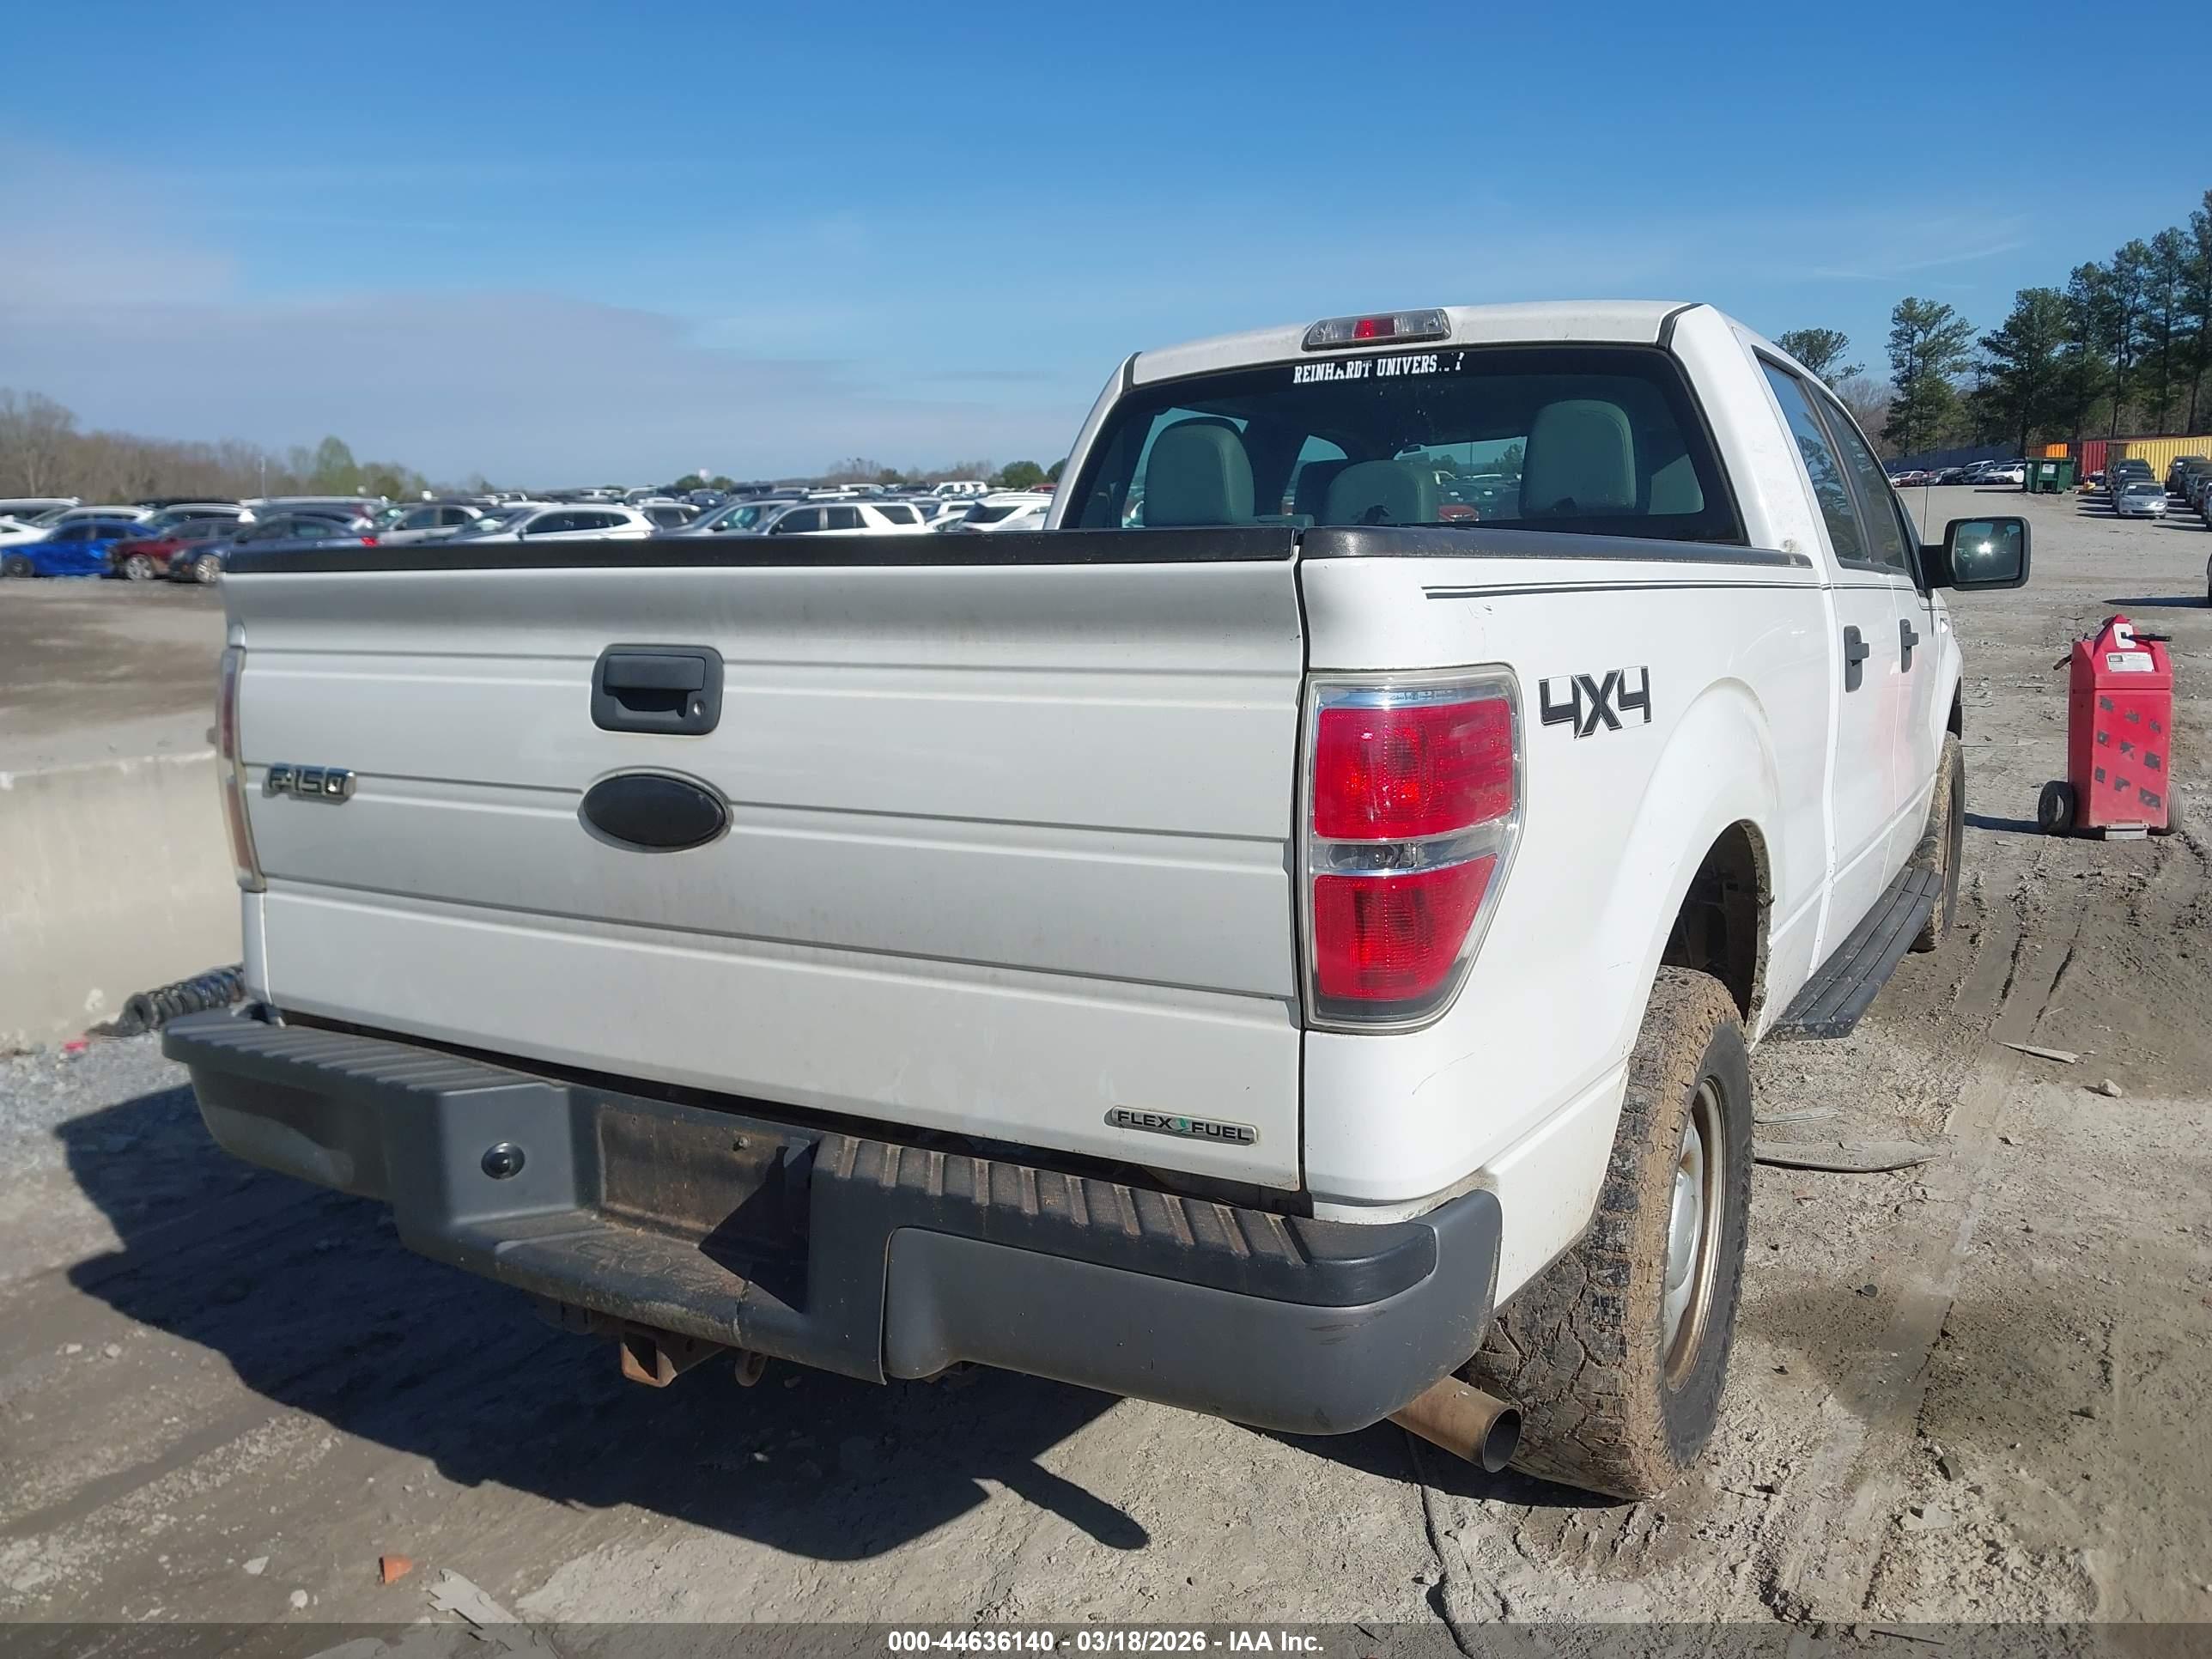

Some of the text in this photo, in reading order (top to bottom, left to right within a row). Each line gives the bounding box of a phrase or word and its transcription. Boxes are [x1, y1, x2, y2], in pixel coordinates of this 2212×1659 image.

[1293, 360, 1373, 384] REINHARDT
[1539, 665, 1652, 740] 4X4
[262, 762, 357, 805] F-150
[1117, 1110, 1250, 1142] FLEX FUEL
